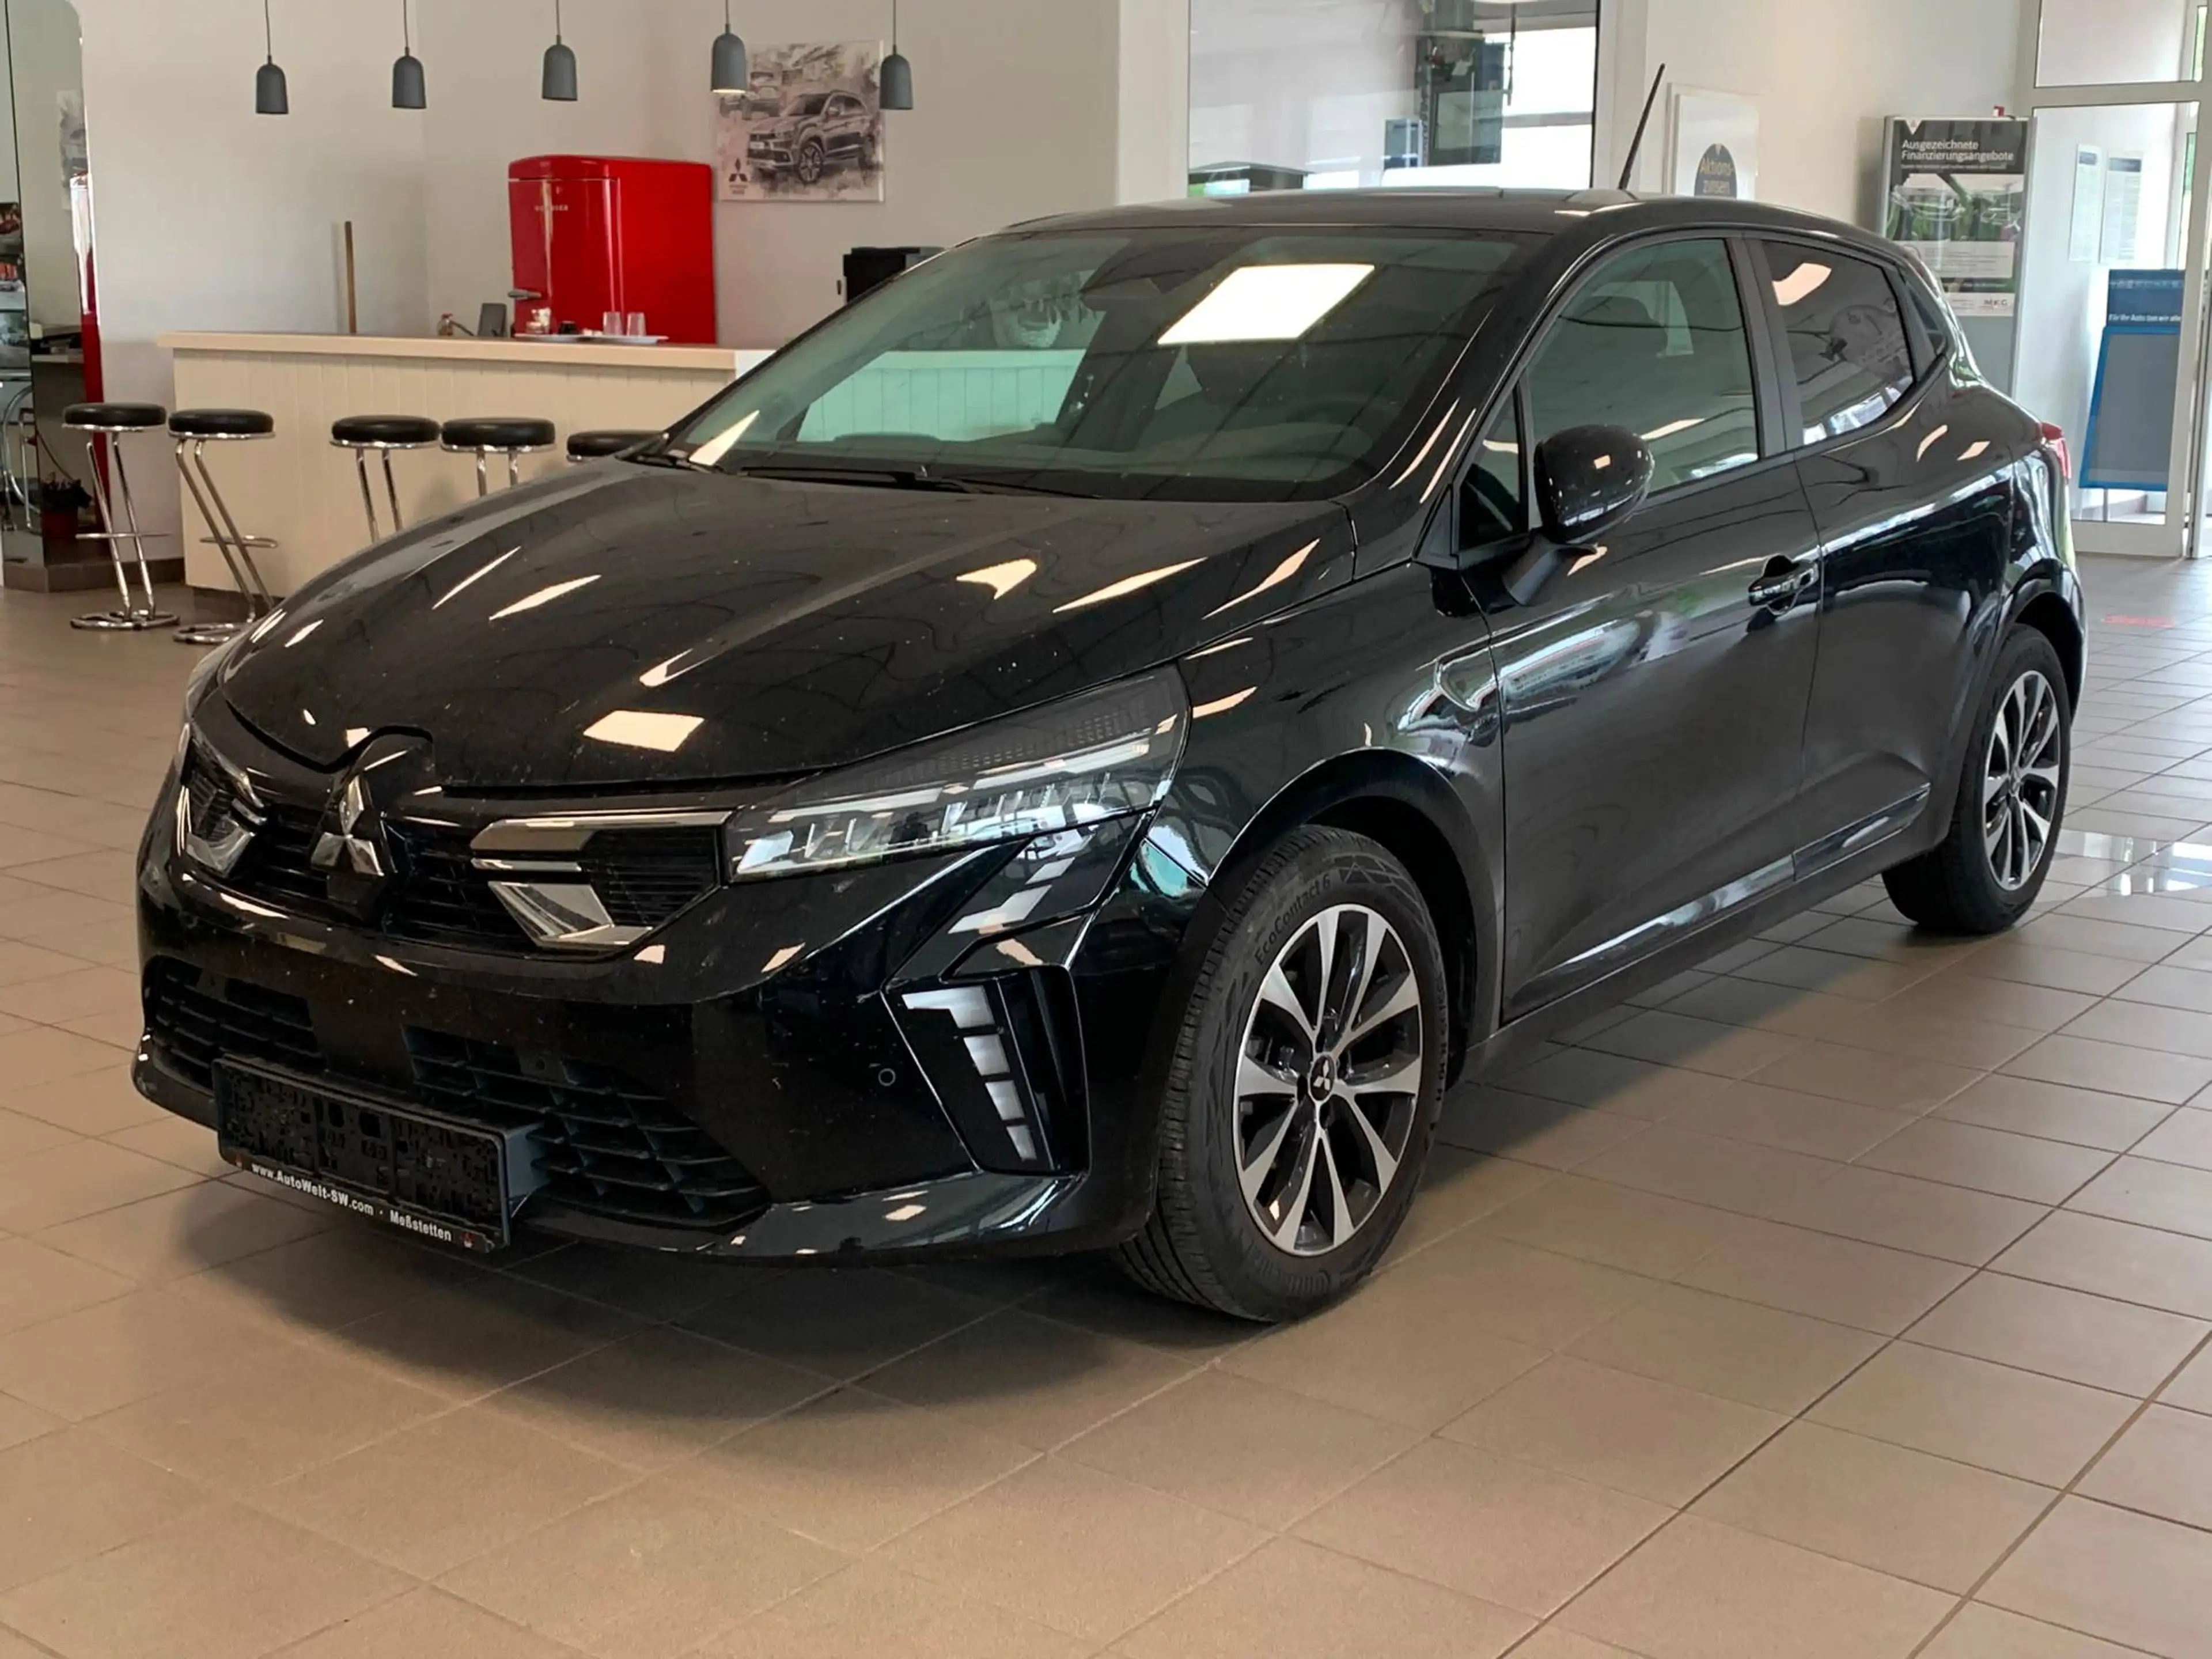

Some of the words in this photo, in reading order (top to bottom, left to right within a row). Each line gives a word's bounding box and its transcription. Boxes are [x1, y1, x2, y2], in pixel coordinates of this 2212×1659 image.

[1902, 139, 1979, 151] Ausgezeichnete
[1902, 150, 2014, 162] Finanzierungsangebote
[1255, 880, 1320, 965] EcoContact
[1323, 873, 1330, 889] 6
[251, 1163, 373, 1215] www.AutoWelt-SW.com
[390, 1210, 452, 1241] Meßstetten
